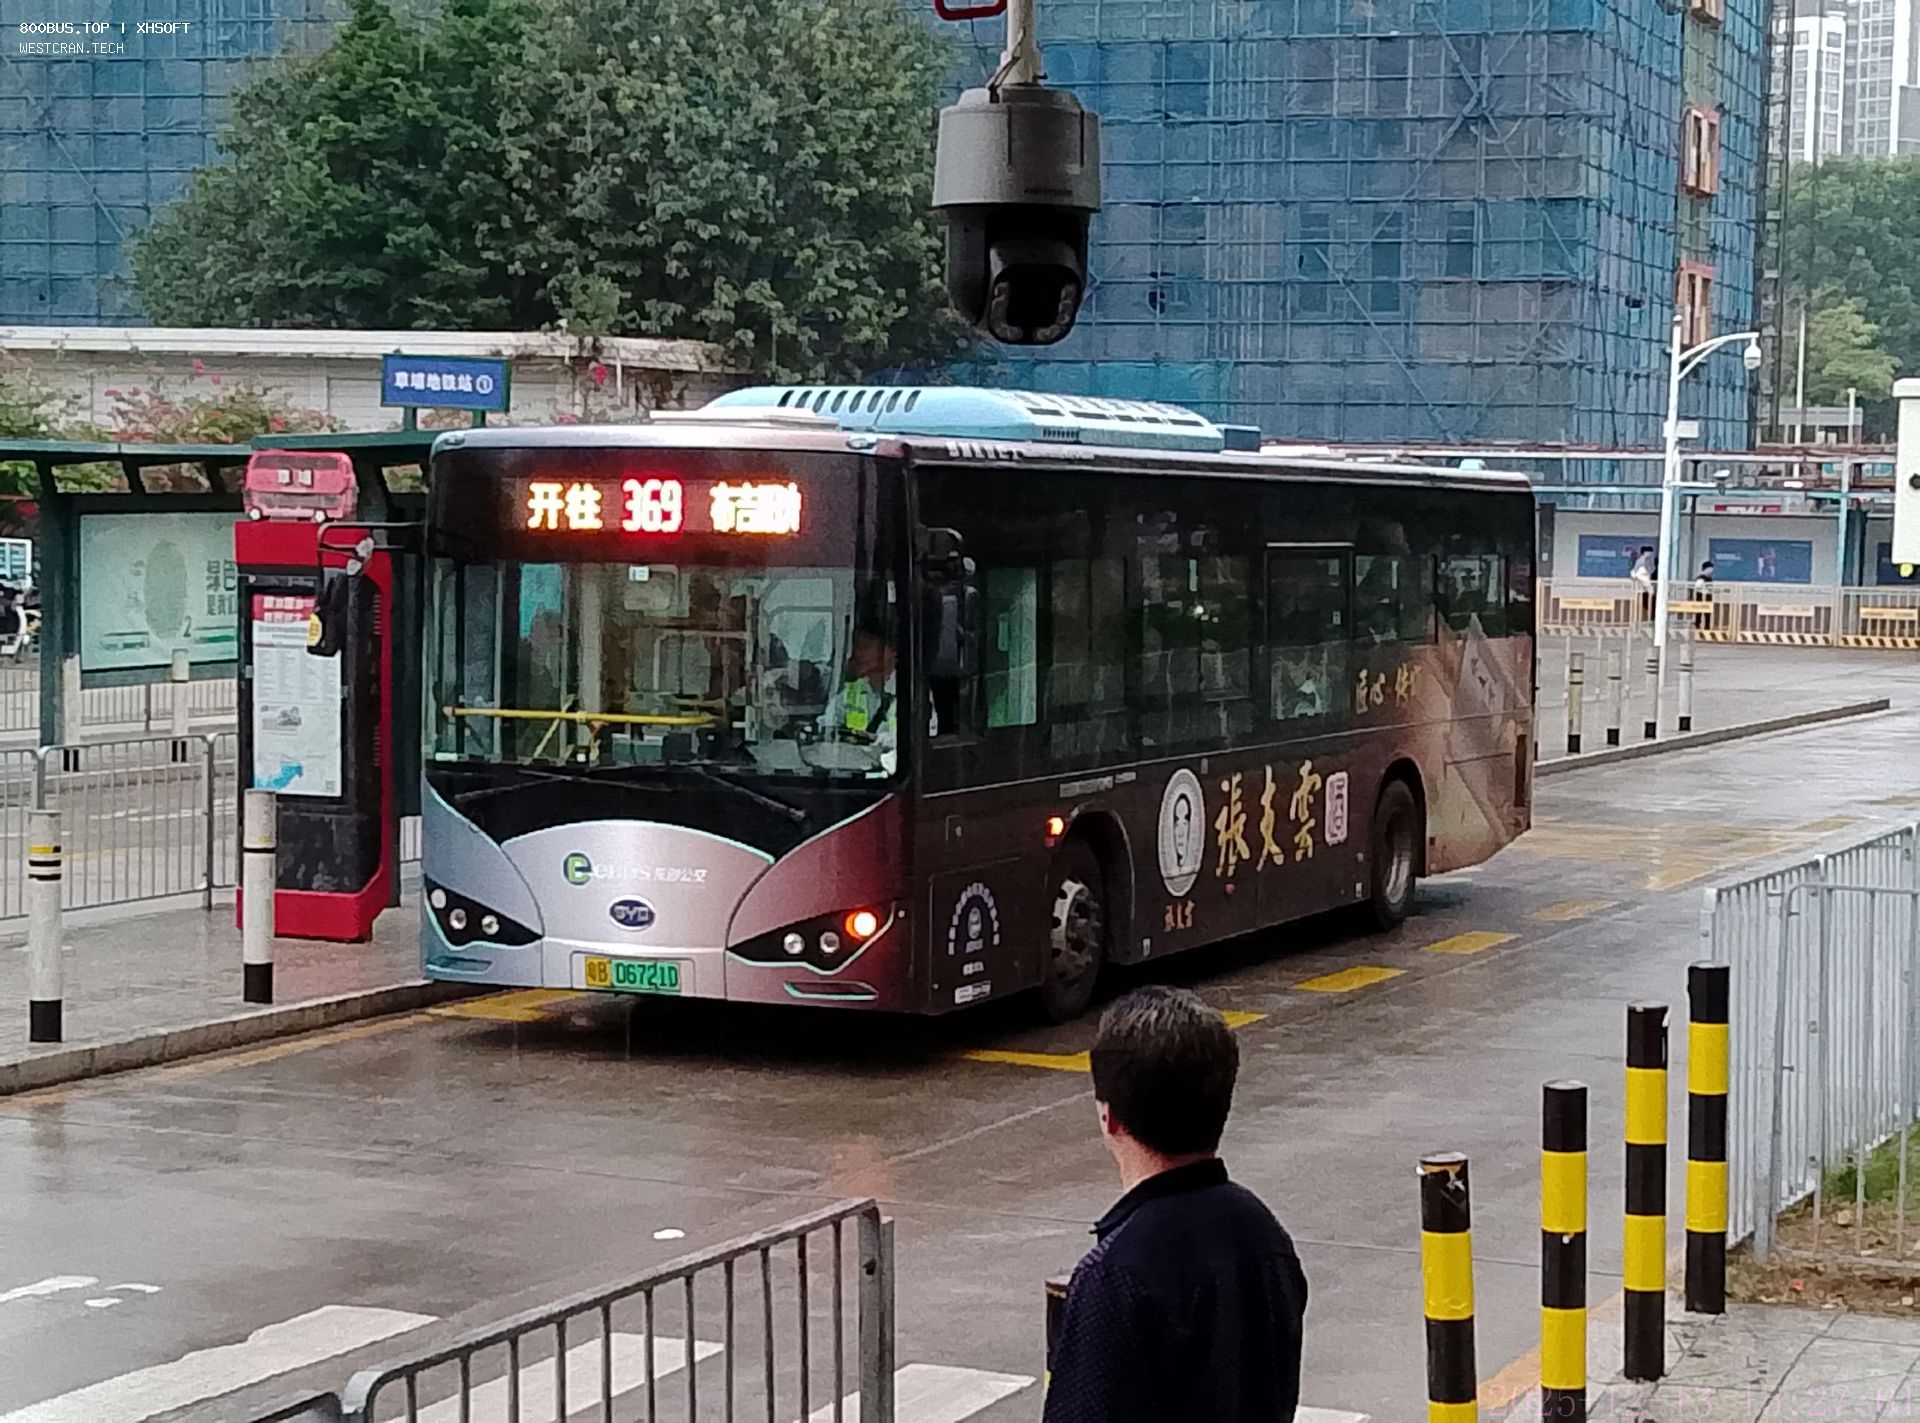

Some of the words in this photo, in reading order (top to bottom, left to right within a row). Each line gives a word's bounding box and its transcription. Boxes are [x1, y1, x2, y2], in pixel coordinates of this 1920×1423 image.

[527, 482, 603, 530] 开往
[622, 478, 683, 533] 369
[613, 905, 649, 922] BYD
